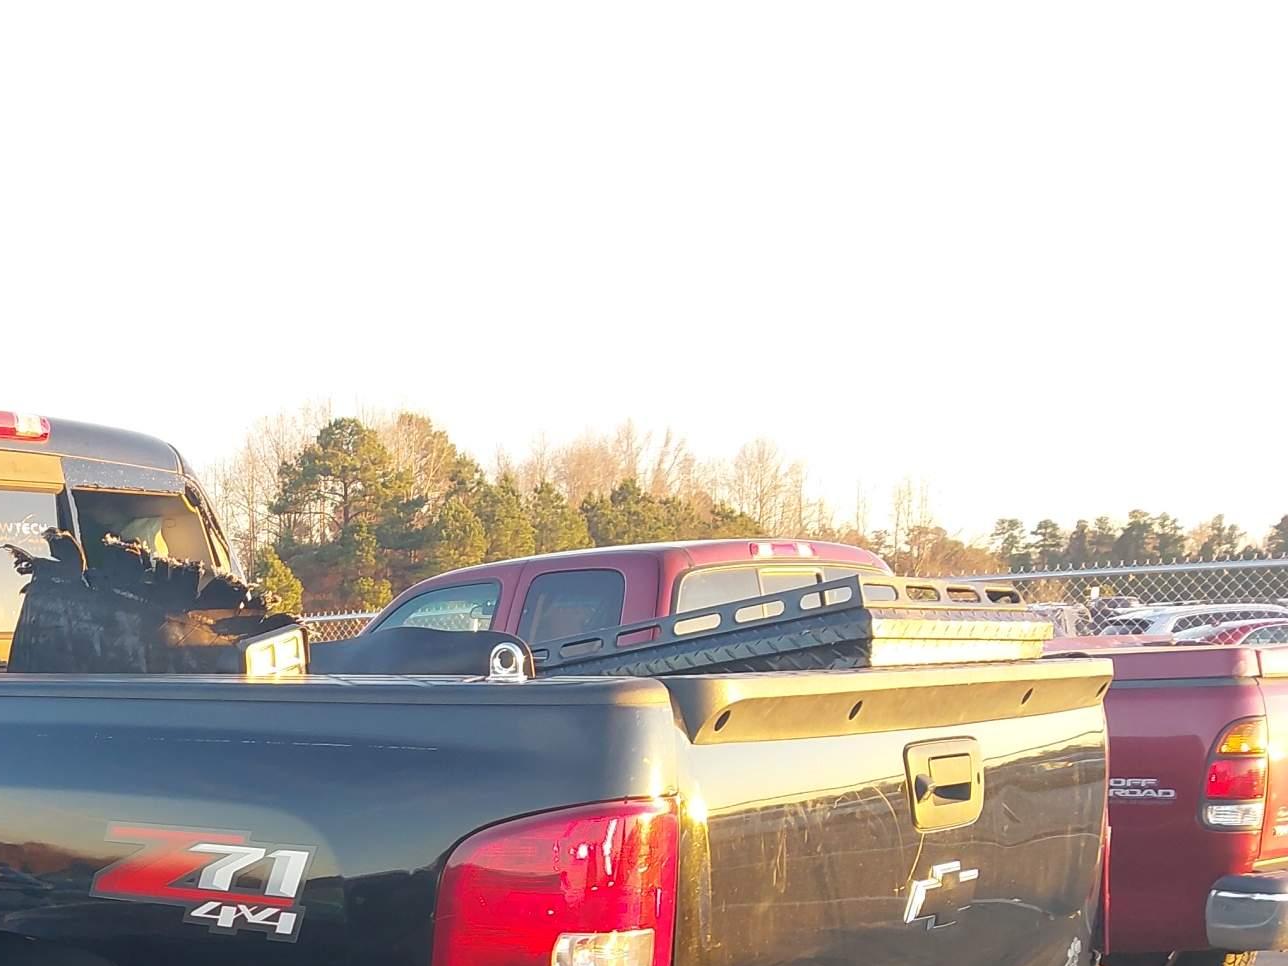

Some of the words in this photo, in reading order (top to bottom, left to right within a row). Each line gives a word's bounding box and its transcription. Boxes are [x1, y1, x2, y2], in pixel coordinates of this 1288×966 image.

[1109, 778, 1159, 787] OFF
[1109, 788, 1176, 798] ROAD
[96, 826, 310, 907] Z71
